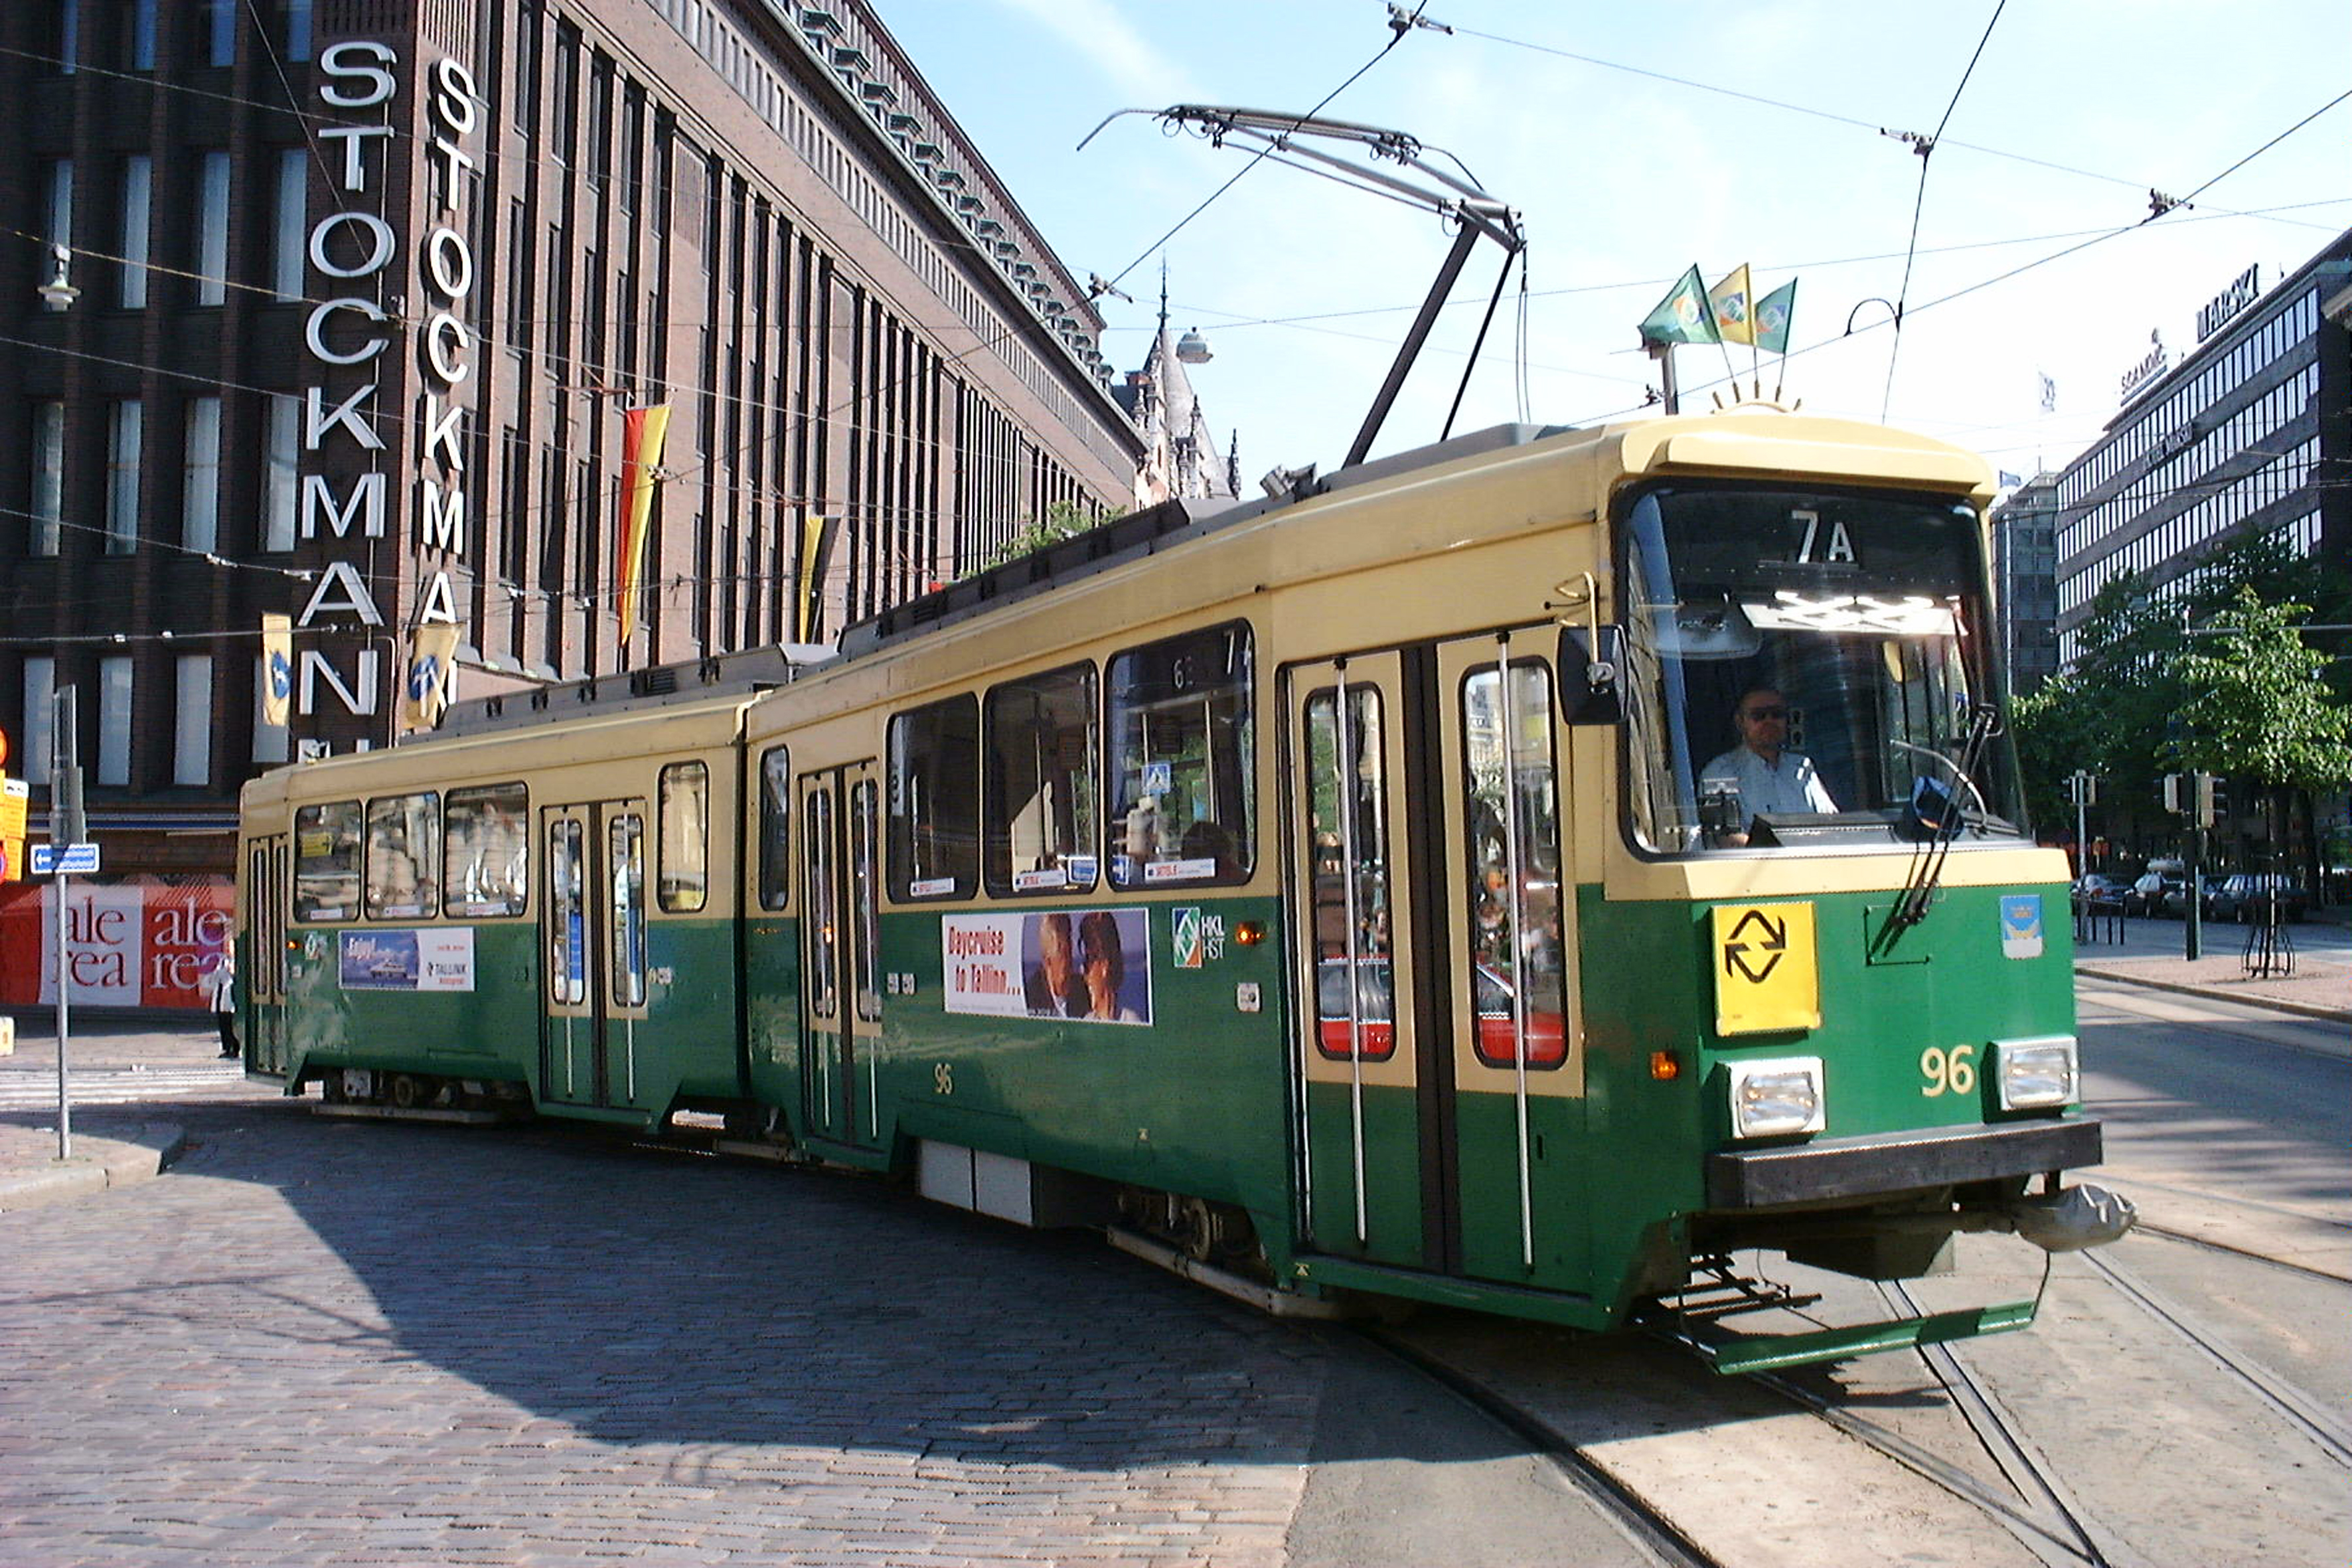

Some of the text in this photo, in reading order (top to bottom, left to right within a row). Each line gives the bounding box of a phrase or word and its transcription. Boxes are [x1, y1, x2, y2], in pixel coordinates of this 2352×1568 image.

[1792, 510, 1855, 564] 7A
[948, 925, 1004, 960] Daycruise
[1201, 915, 1225, 937] HKL
[1202, 938, 1225, 959] HST
[955, 965, 967, 994] to
[935, 1062, 953, 1095] 96
[1921, 1044, 1973, 1097] 96
